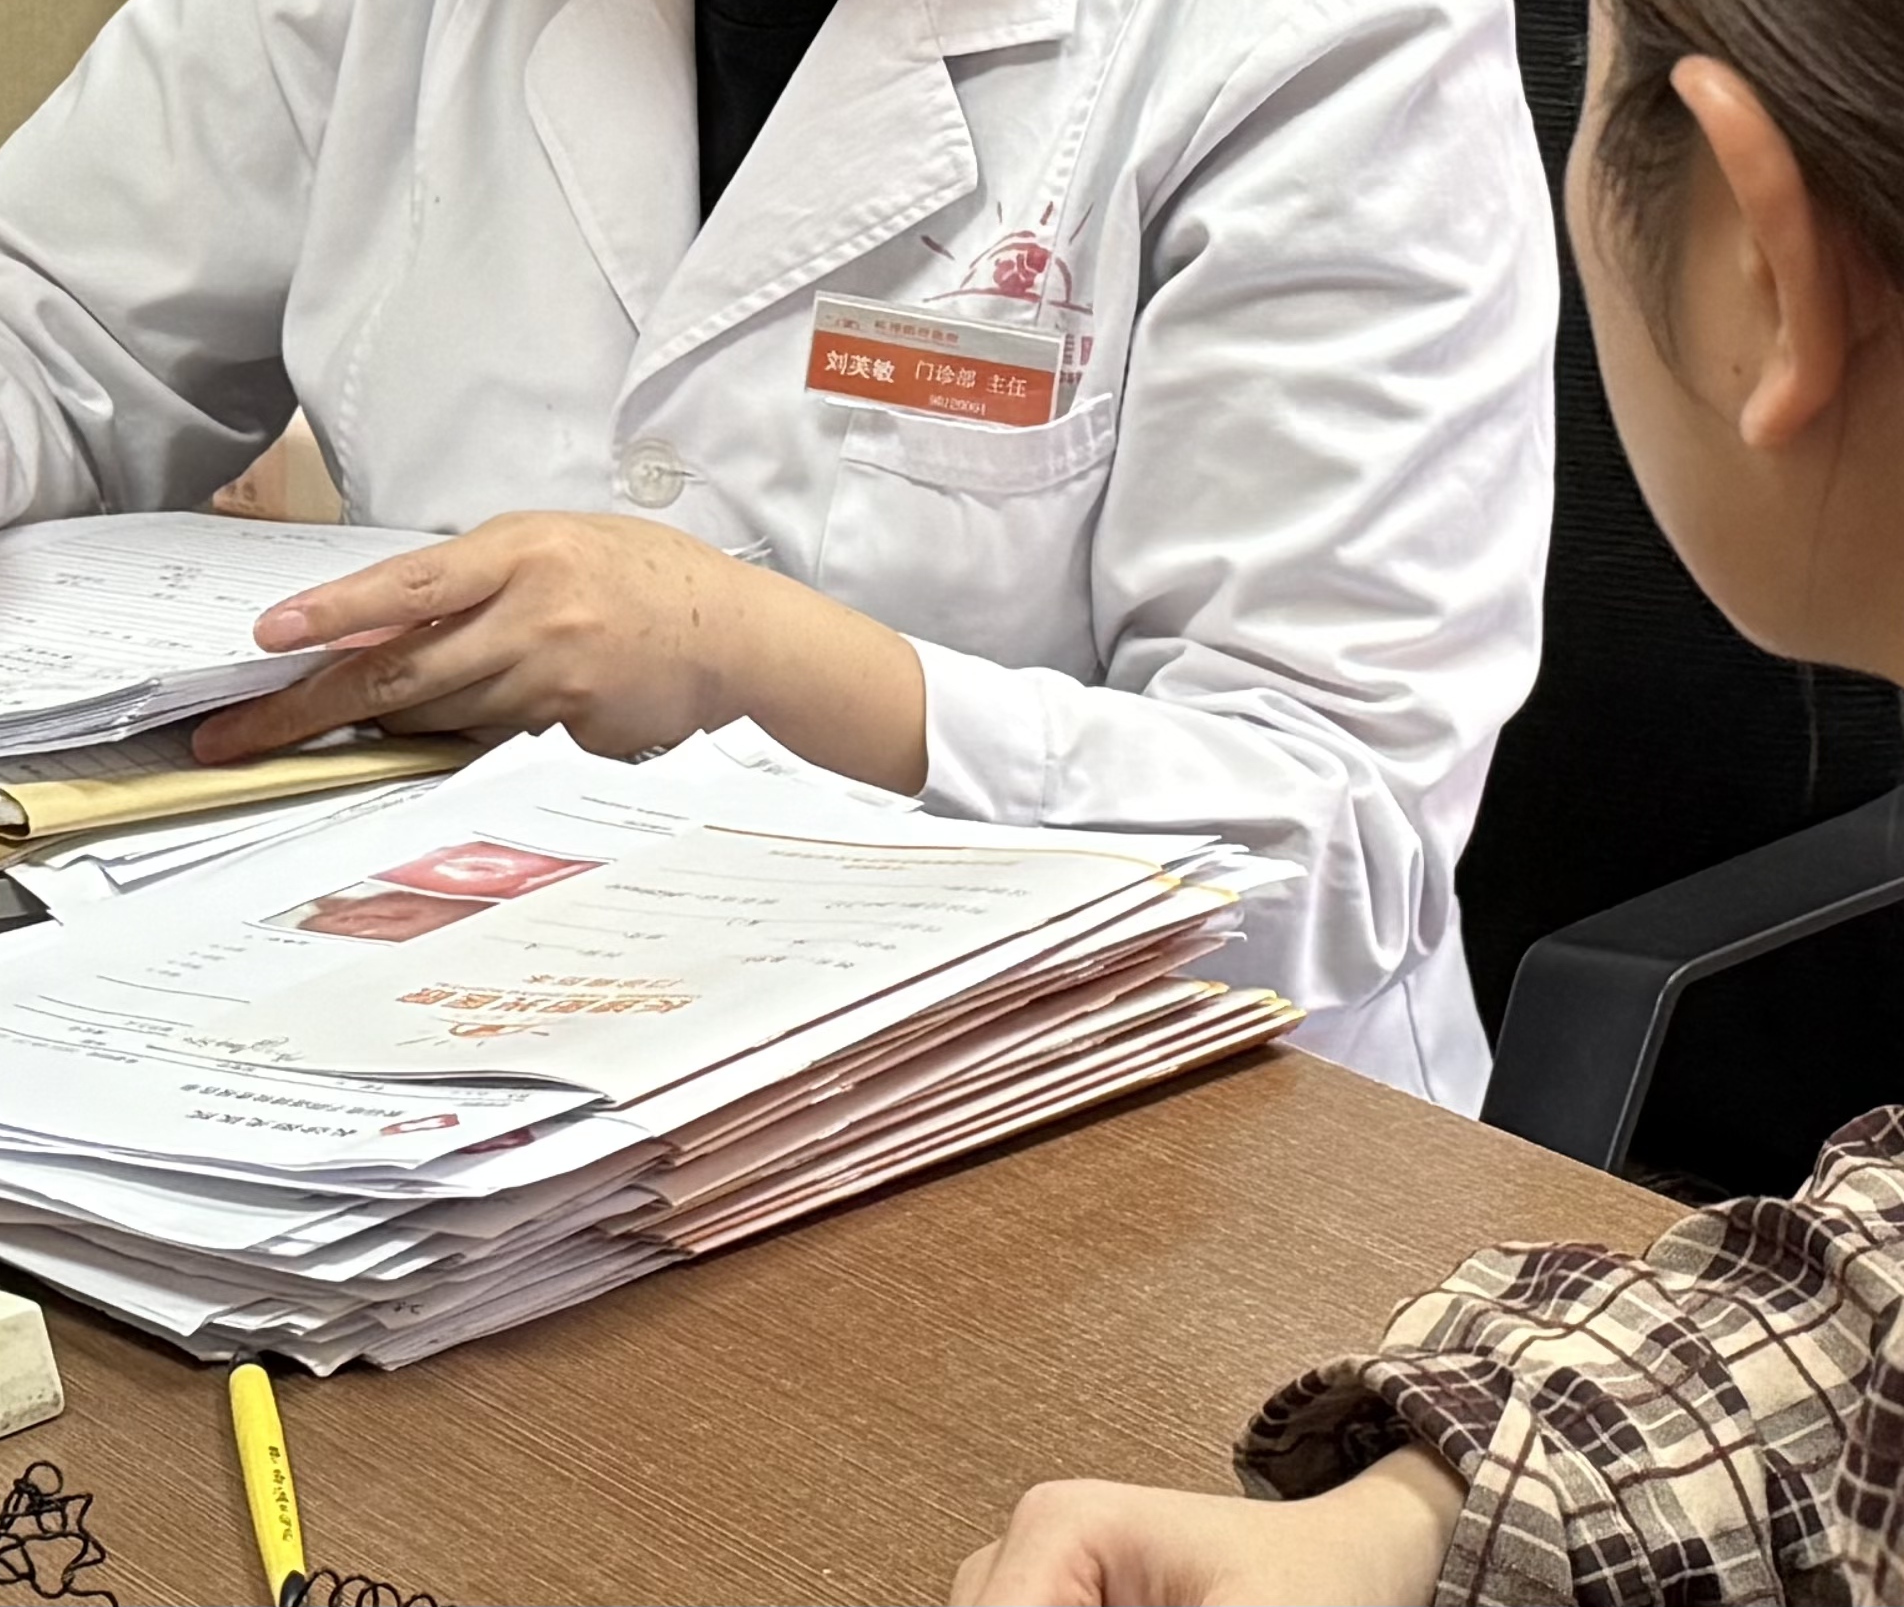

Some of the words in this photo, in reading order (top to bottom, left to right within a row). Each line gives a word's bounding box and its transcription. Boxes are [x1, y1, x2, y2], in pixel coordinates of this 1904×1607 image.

[914, 358, 977, 389] 门诊部
[985, 373, 1028, 399] 主任
